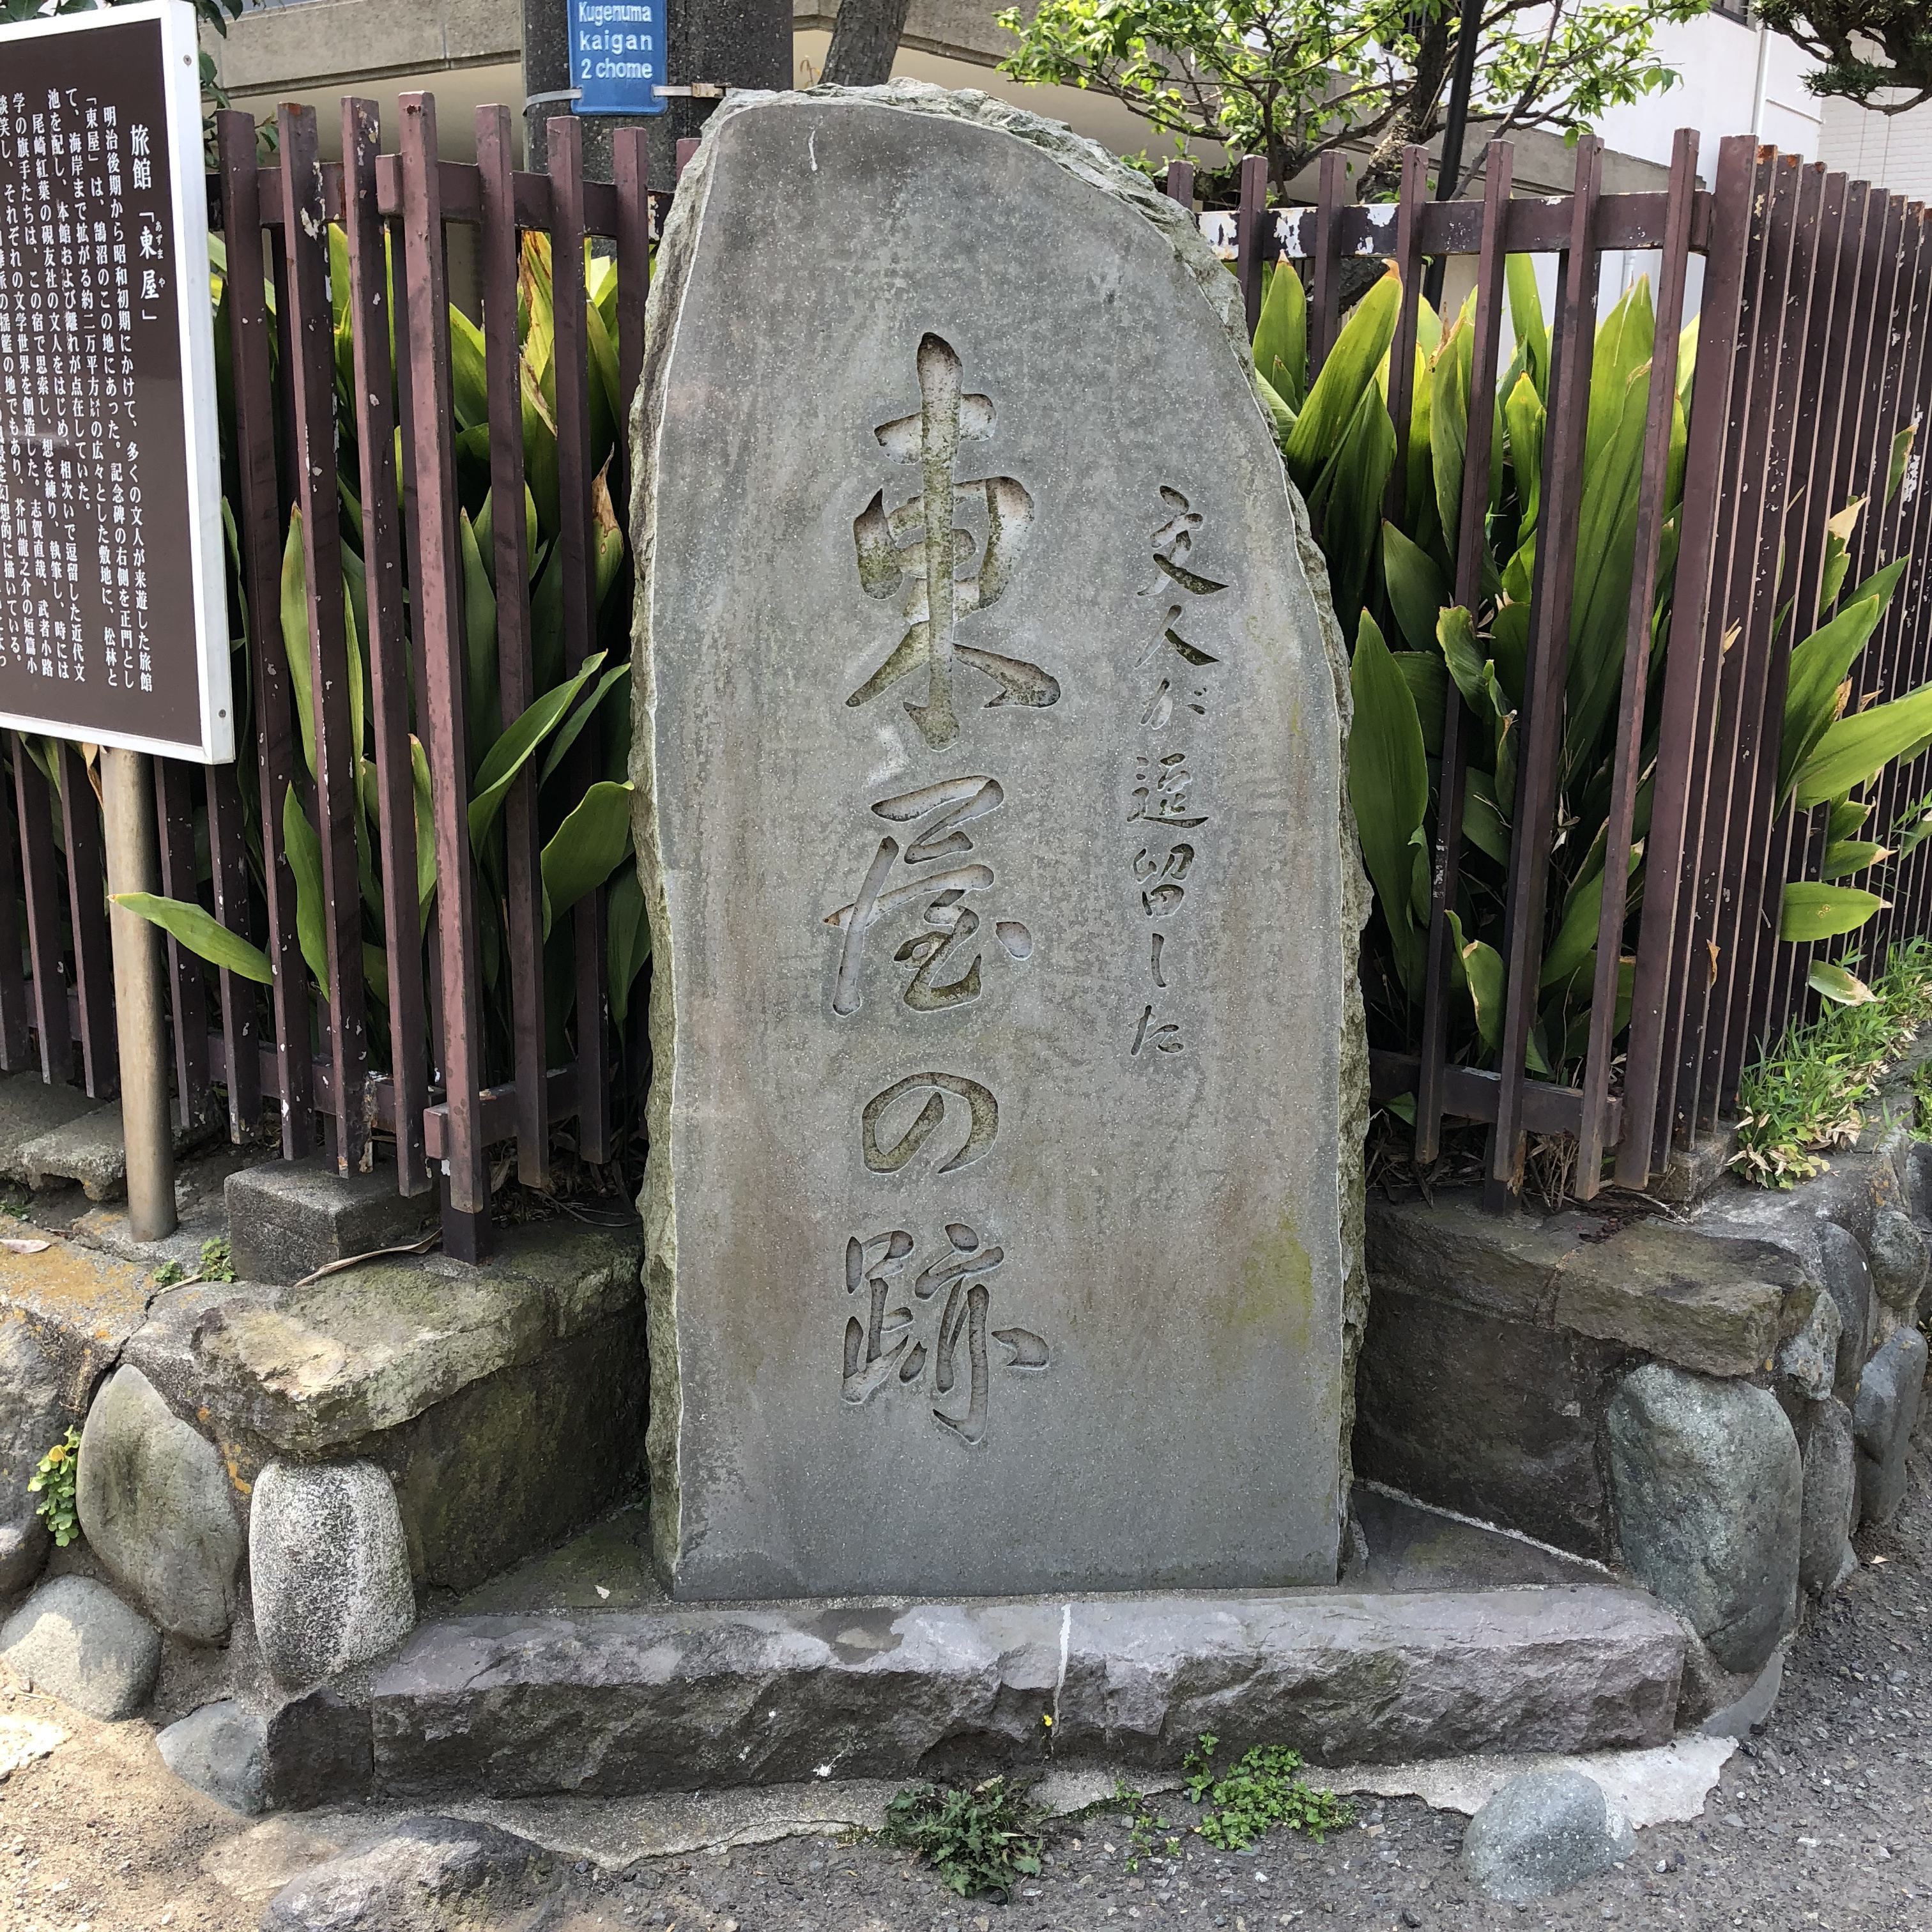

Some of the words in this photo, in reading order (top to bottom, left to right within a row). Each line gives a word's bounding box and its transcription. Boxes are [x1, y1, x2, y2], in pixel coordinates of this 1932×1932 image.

[579, 1, 652, 26] Kugenuma
[580, 30, 652, 55] kaigan
[581, 58, 592, 79] 2
[595, 58, 653, 79] chome
[130, 124, 160, 319] 旅館「東屋」
[823, 332, 1061, 1445] 東屋の跡
